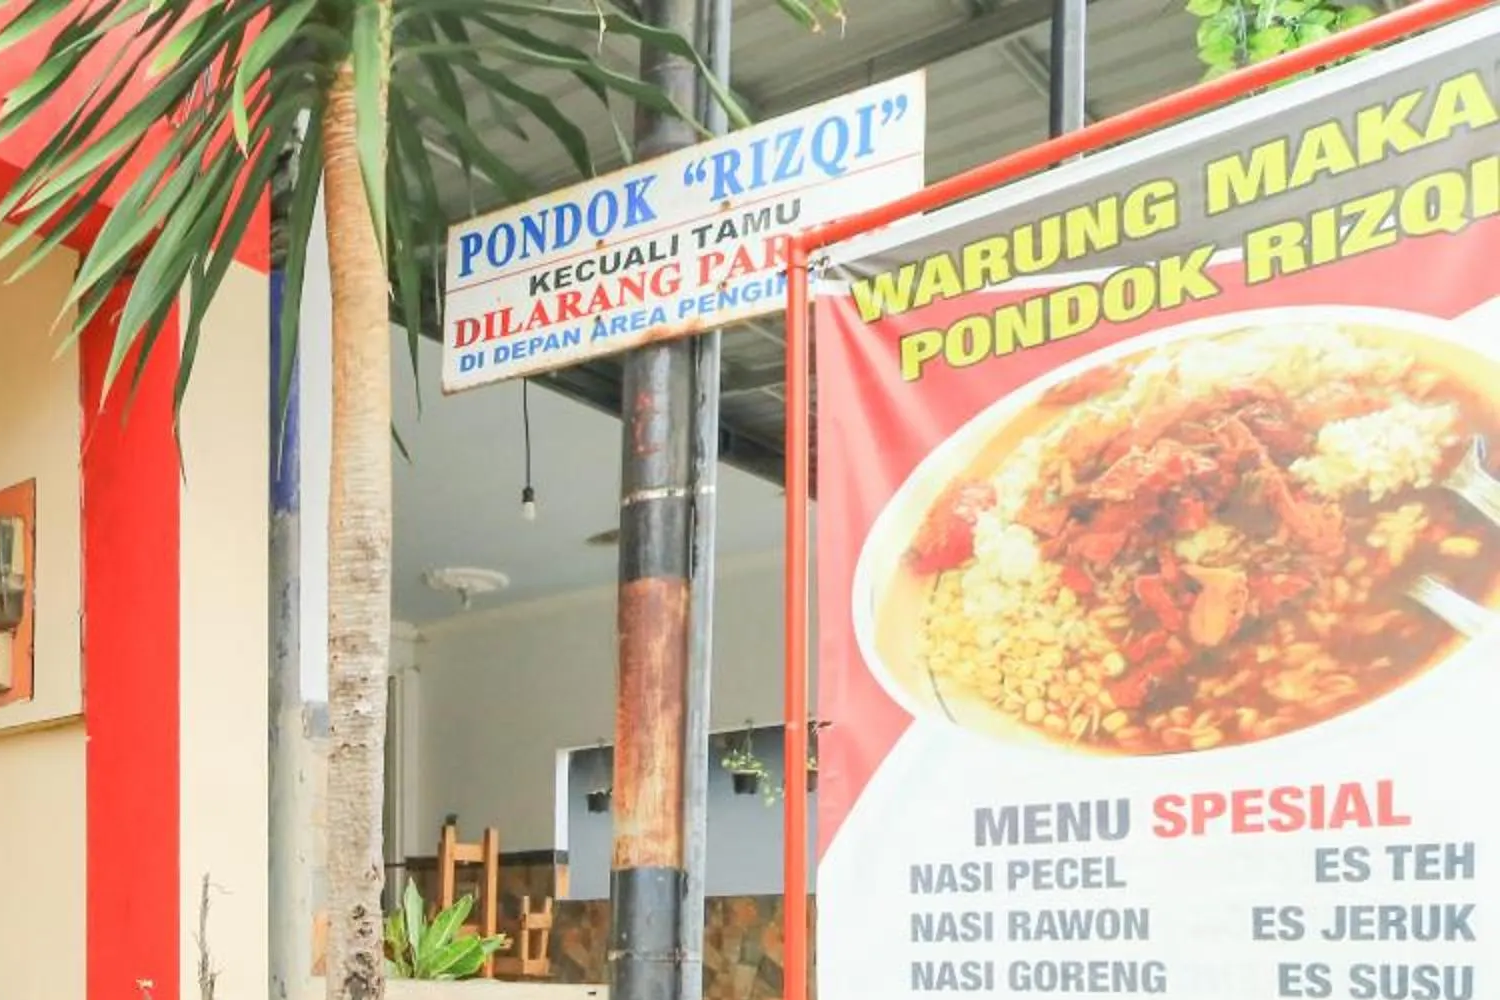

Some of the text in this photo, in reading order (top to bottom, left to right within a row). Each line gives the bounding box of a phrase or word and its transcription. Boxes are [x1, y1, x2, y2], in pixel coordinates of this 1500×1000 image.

[458, 174, 659, 277] PONDOK
[850, 70, 1500, 325] WARUNG MAKA
[529, 198, 801, 297] KECUALI TAMU
[900, 155, 1500, 382] PONDOK RIZQI
[453, 234, 789, 348] DILARANG PAR
[460, 351, 485, 373] DI
[494, 327, 581, 365] DEPAN
[590, 309, 667, 342] AREA
[974, 780, 1411, 847] MENU SPESIAL
[909, 856, 1127, 894] NASI PECEL
[1314, 842, 1476, 883] ES TEH
[910, 908, 1150, 942] NASI RAWON
[1252, 903, 1477, 942] ES JERUK
[910, 960, 1167, 994] NASI GORENG
[1277, 962, 1332, 999] ES
